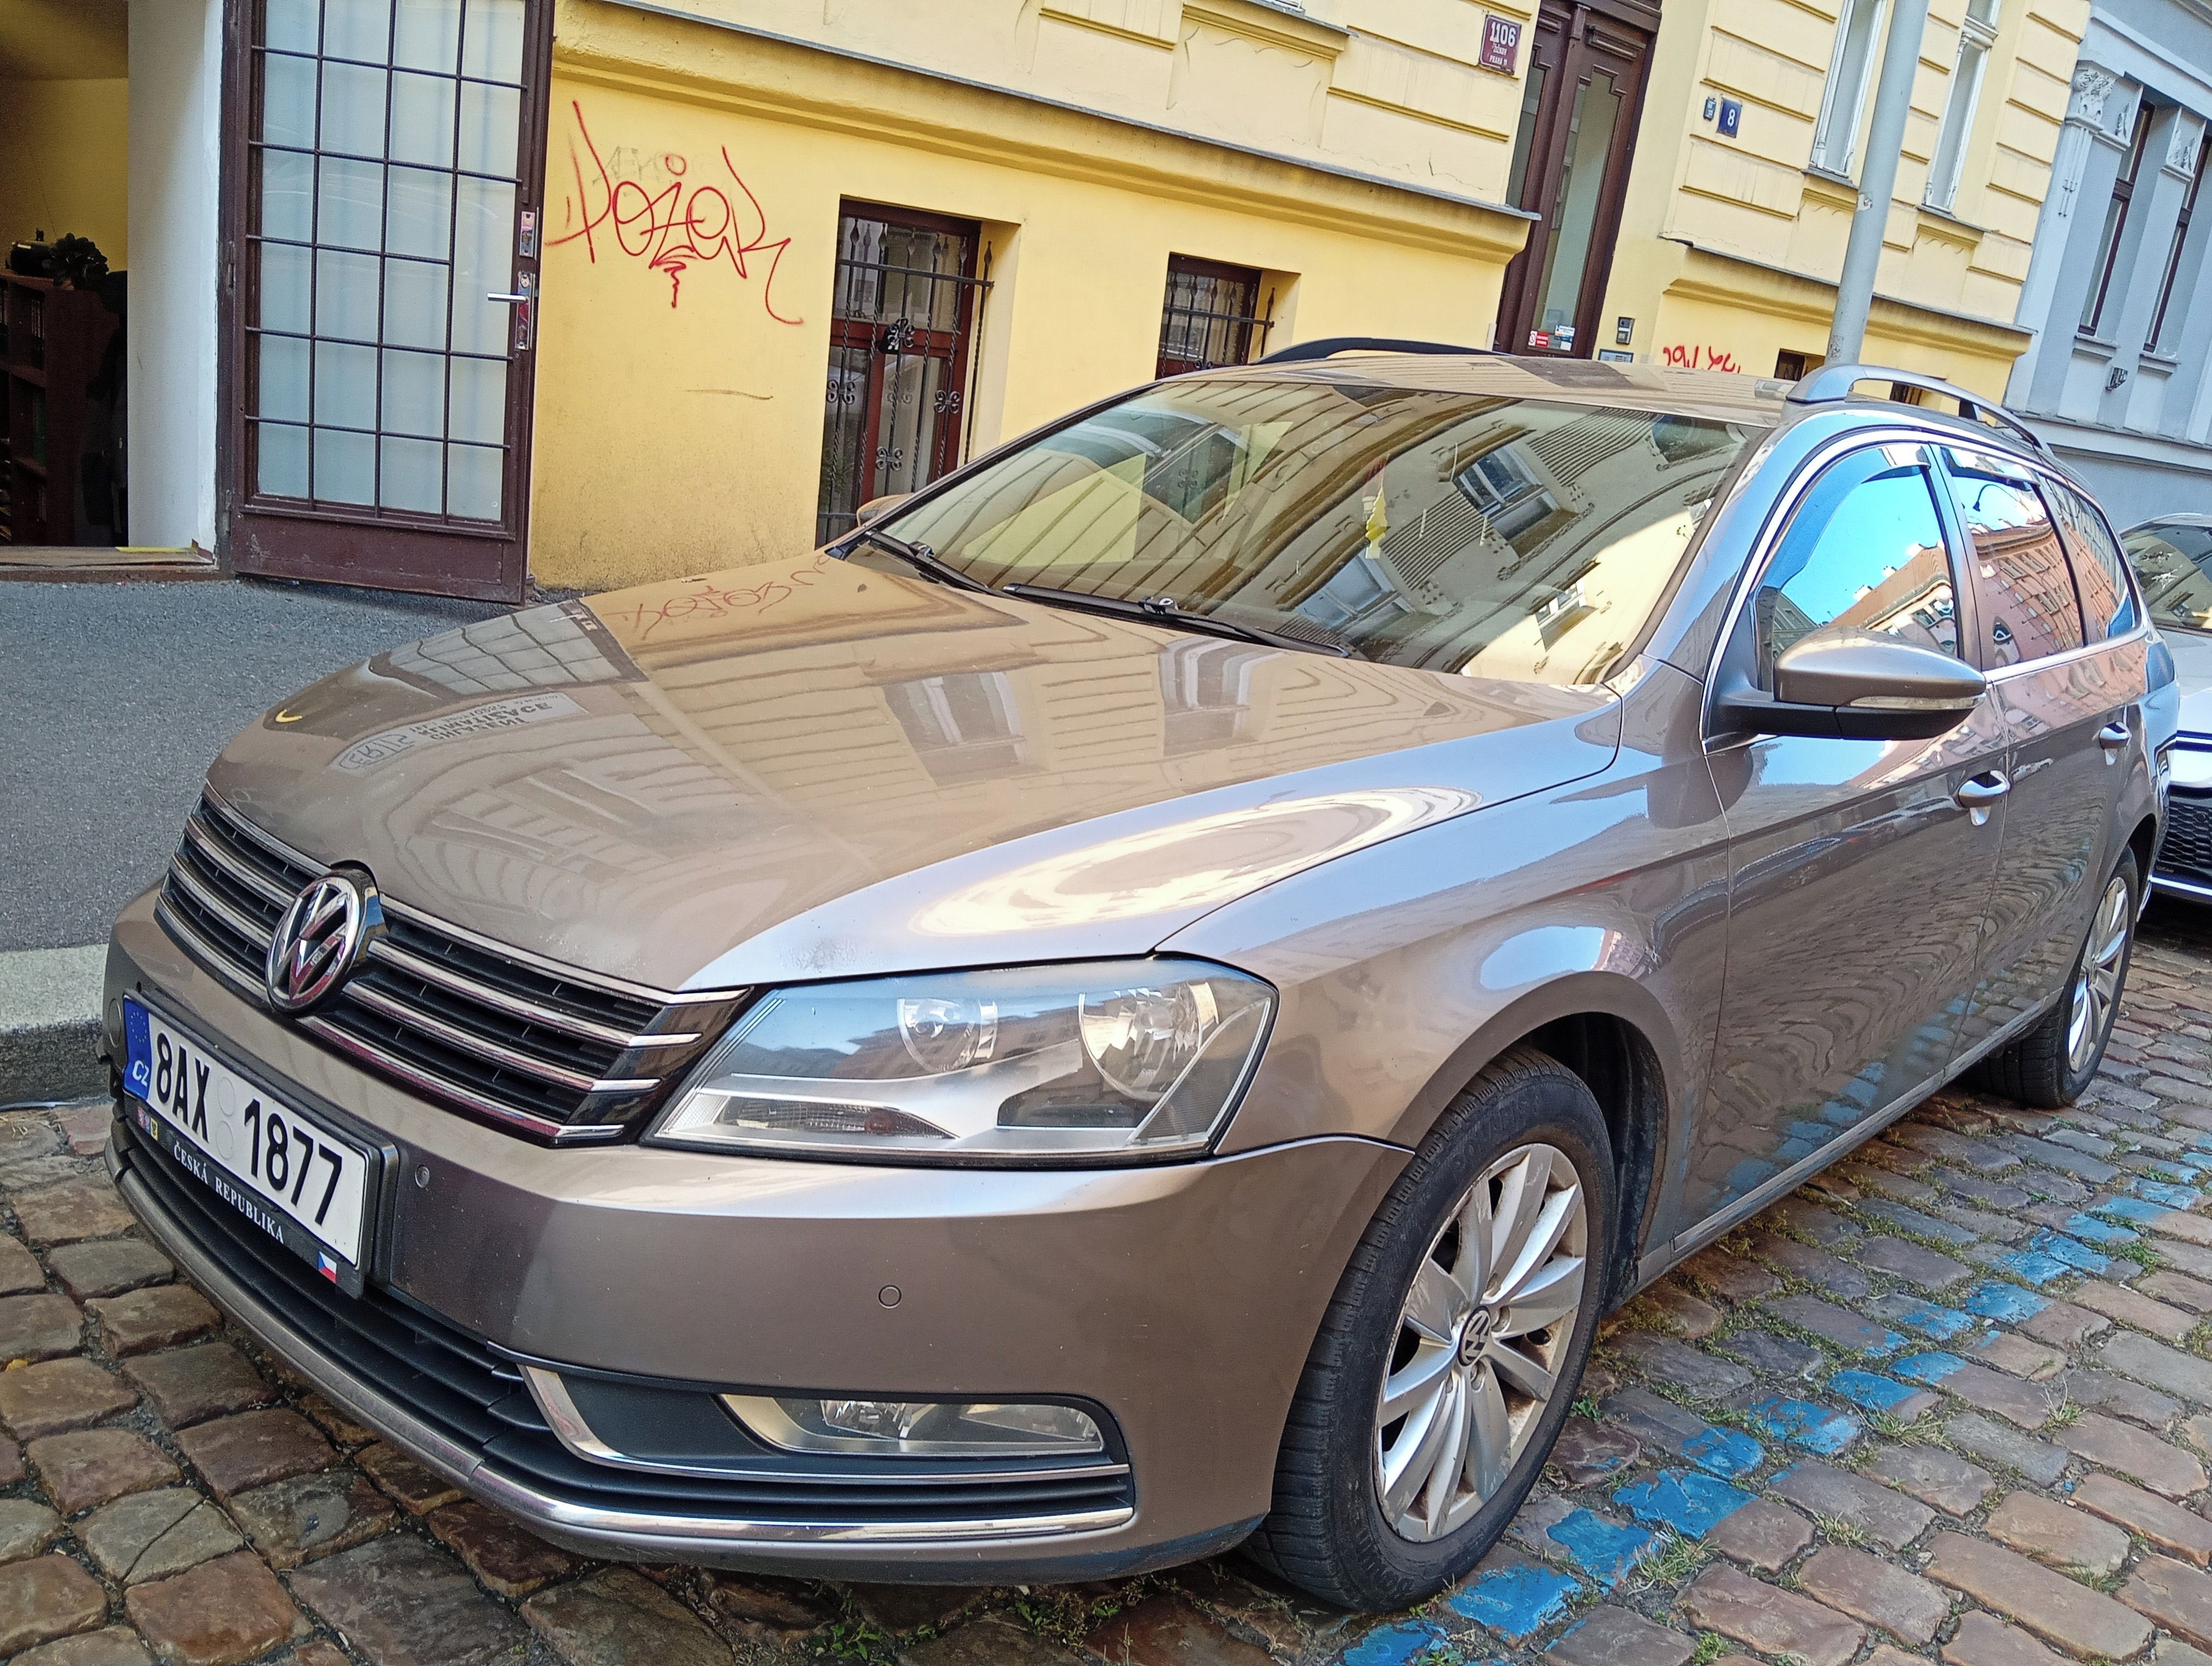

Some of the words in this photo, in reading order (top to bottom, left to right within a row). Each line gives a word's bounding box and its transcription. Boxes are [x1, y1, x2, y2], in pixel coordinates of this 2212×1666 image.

[1489, 22, 1516, 47] 1106
[1489, 55, 1503, 65] PRAHA
[1727, 109, 1735, 127] 8
[132, 1060, 150, 1087] CZ
[156, 1032, 210, 1143] 8AX
[244, 1098, 343, 1226] 1877
[174, 1140, 208, 1185] ČESKÁ
[215, 1176, 284, 1245] REPUBLIKA
